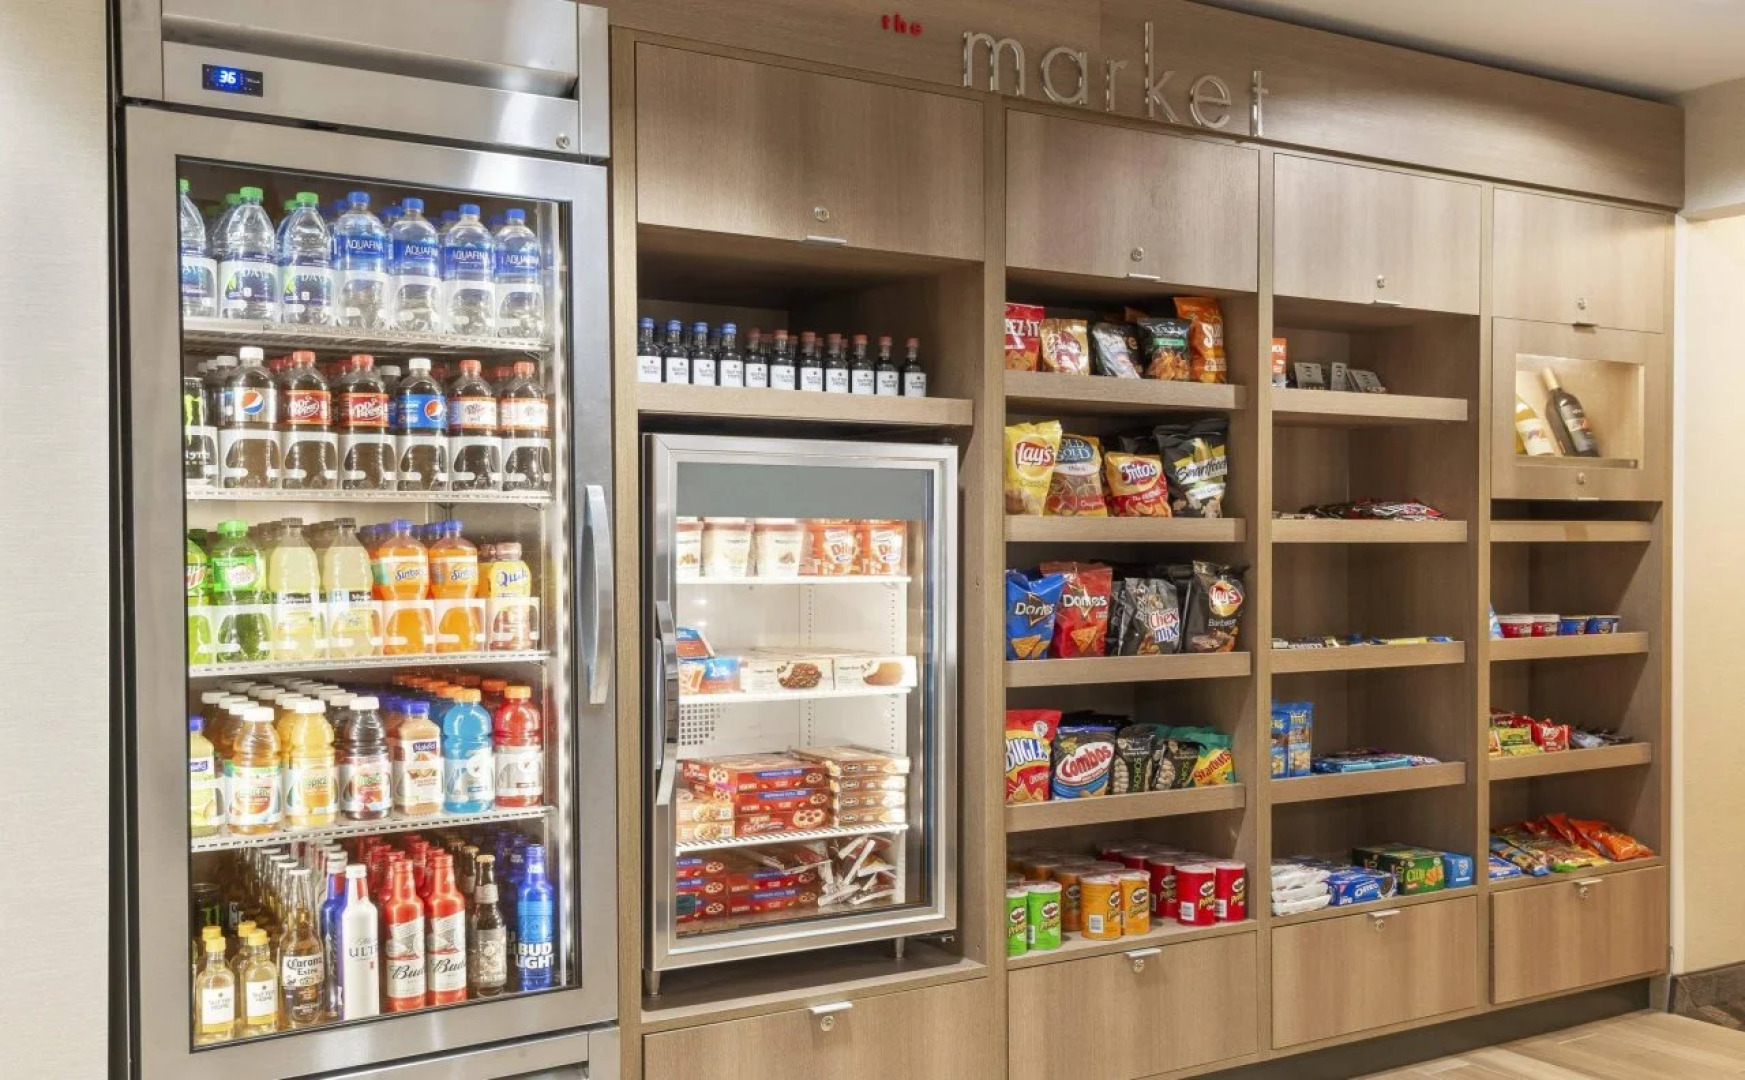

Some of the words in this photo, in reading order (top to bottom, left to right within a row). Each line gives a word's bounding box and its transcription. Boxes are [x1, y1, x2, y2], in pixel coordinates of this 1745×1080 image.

[219, 70, 237, 84] 36
[881, 13, 924, 36] the
[963, 21, 1269, 138] market
[1061, 439, 1085, 448] OLD
[1018, 442, 1052, 466] Lay's
[1120, 462, 1157, 484] Fritos
[1063, 594, 1107, 608] Doritos
[1061, 745, 1113, 777] Combos
[518, 942, 553, 956] BUD
